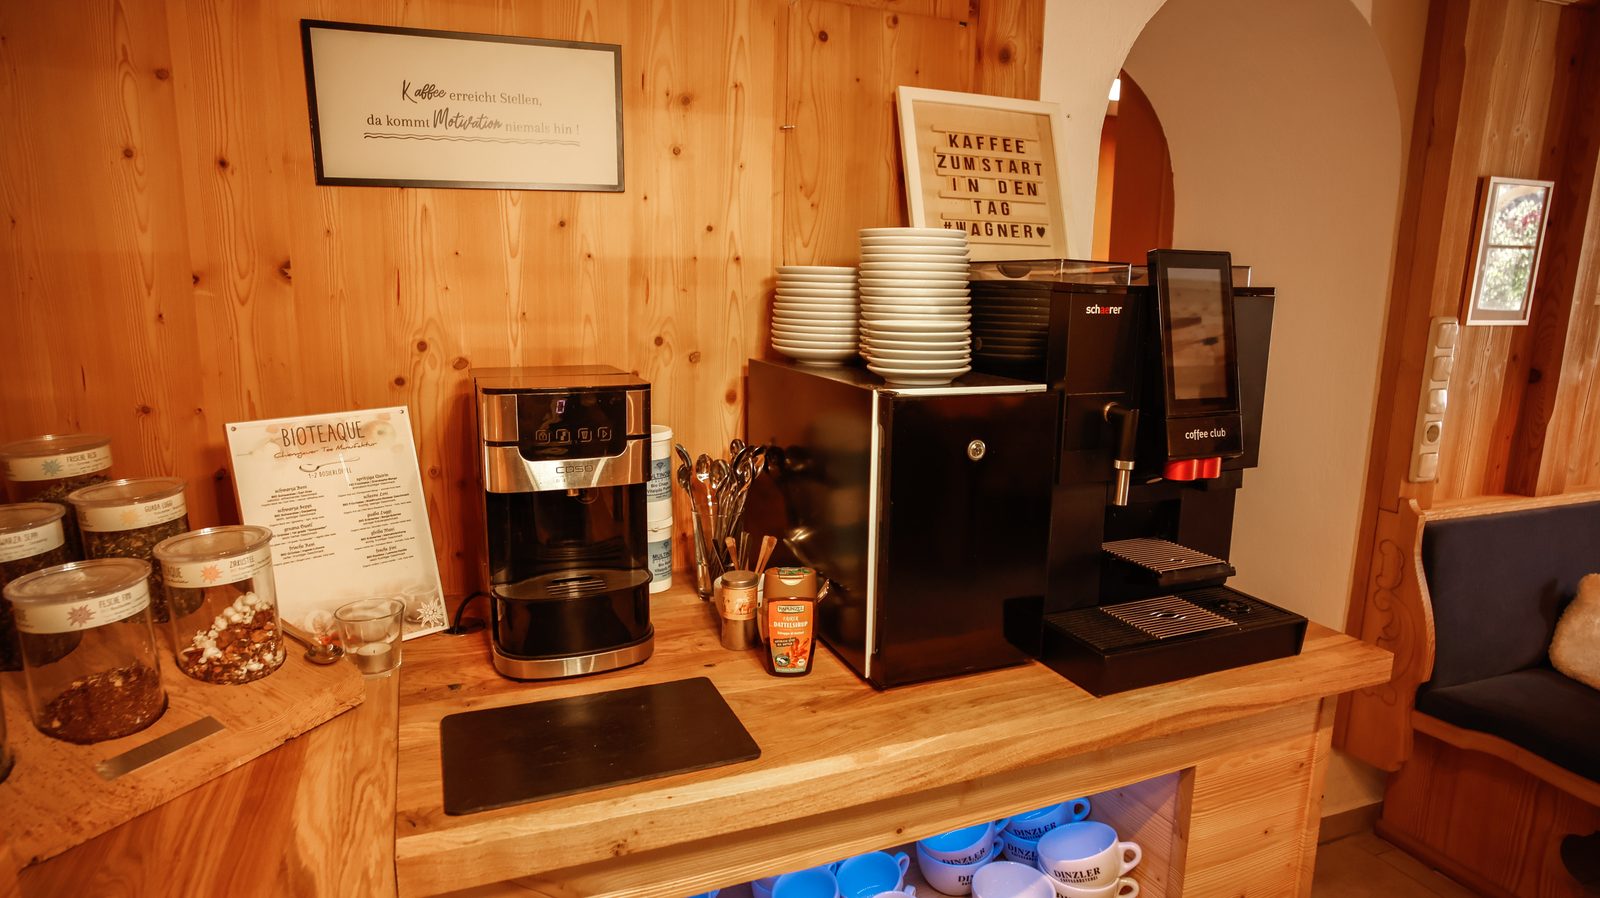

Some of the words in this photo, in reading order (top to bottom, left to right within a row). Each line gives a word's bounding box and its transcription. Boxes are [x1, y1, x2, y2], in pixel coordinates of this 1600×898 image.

[401, 79, 446, 104] Kaffee
[449, 91, 497, 103] erreicht
[500, 92, 542, 107] Stellen,
[366, 113, 383, 126] da
[386, 115, 430, 128] kommt
[433, 107, 504, 130] Motivation
[505, 121, 551, 134] niemals
[554, 122, 573, 135] hin
[948, 134, 1025, 154] KAFFEE
[952, 177, 980, 192] IN
[998, 180, 1037, 196] DEN
[974, 200, 1010, 216] TAG
[1085, 303, 1122, 315] schaerer
[281, 420, 366, 447] BIOTEAQUE
[1184, 428, 1209, 441] coffee
[1209, 427, 1226, 438] club
[321, 445, 334, 453] Tee
[336, 441, 378, 451] Manufaktur
[1014, 822, 1057, 836] DINZLER
[1007, 843, 1038, 858] DINZL
[1054, 867, 1101, 880] DINZLER
